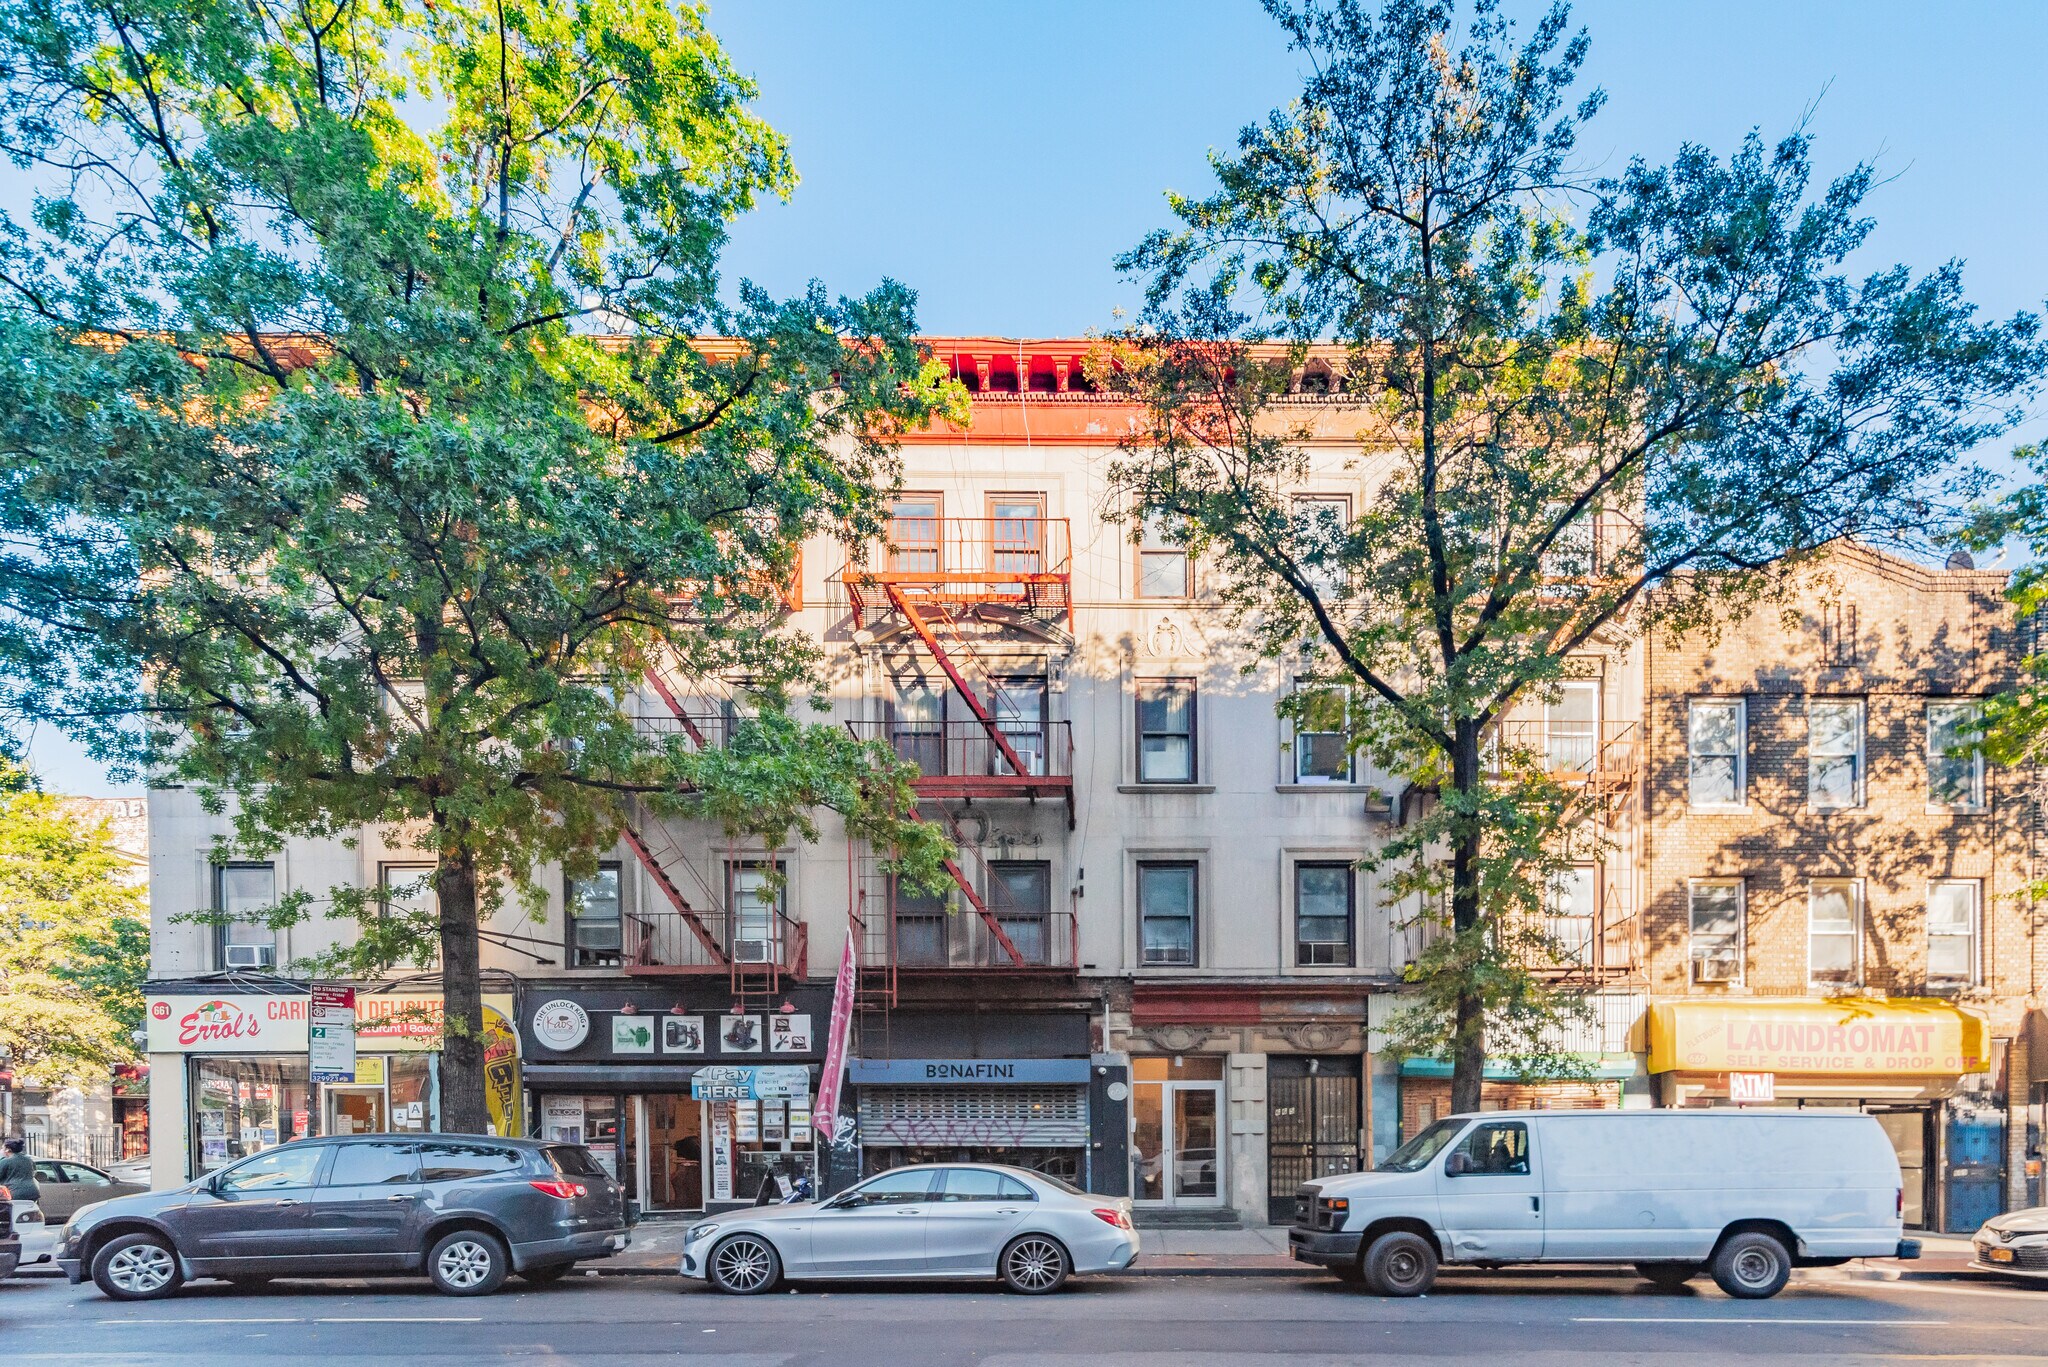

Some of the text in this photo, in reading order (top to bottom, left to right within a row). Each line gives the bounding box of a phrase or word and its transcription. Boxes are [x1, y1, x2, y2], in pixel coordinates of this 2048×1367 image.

[153, 1006, 171, 1015] 661
[536, 1002, 587, 1024] THE UNLOCK KING
[178, 1012, 261, 1045] Errol's
[315, 1028, 323, 1037] 2
[1686, 1024, 1723, 1048] FLATBUSH
[1726, 1023, 1936, 1053] LAUNDROMAT
[1689, 1054, 1705, 1064] 669
[1726, 1055, 1979, 1069] SELF SERVICE & DROP OFF
[711, 1067, 753, 1083] Pay
[926, 1064, 1015, 1078] BONAFINI
[697, 1085, 751, 1099] HERE
[1734, 1072, 1770, 1098] ATM
[411, 1104, 421, 1114] A
